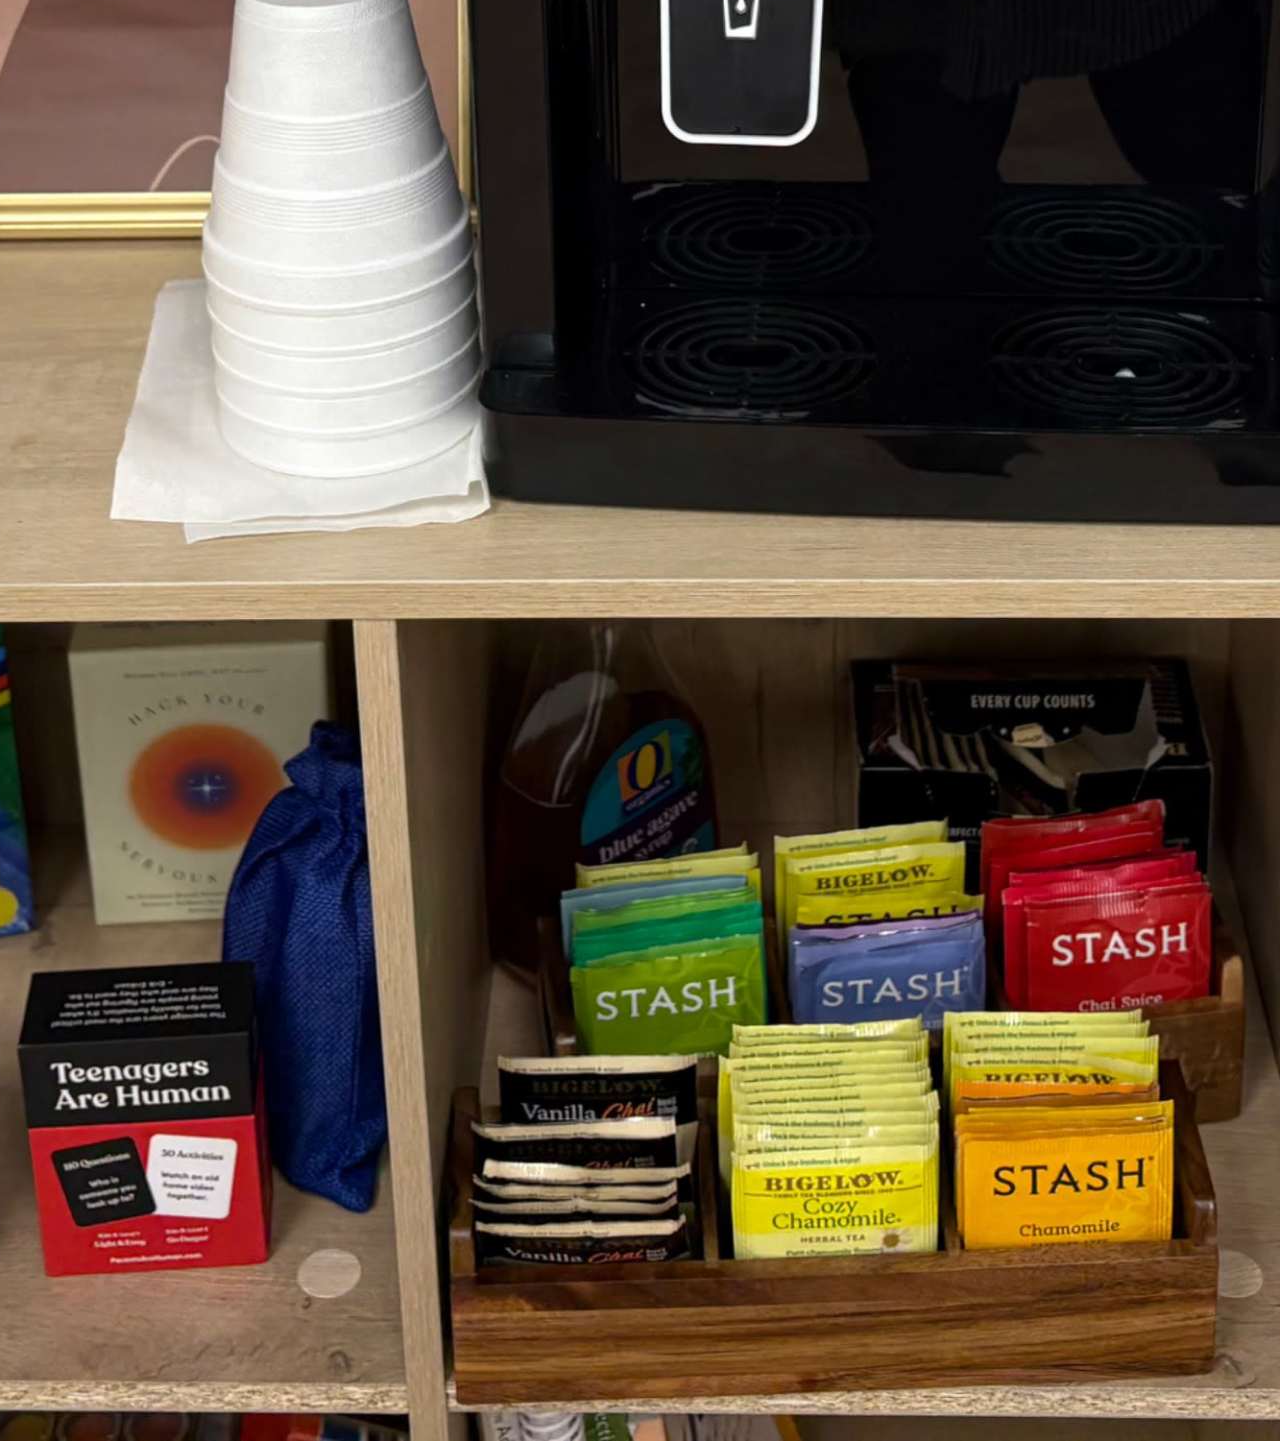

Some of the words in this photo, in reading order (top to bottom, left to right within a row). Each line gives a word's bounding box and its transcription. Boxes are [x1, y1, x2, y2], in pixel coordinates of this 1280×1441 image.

[128, 695, 188, 727] HACK
[203, 692, 266, 716] YOUR
[971, 694, 1011, 709] EVERY
[1014, 694, 1041, 709] CUP
[1043, 693, 1096, 709] COUNTS
[599, 829, 644, 864] blue
[646, 790, 699, 836] agave
[1052, 922, 1188, 967] STASH
[596, 976, 737, 1021] STASH
[822, 969, 961, 1008] STASH
[1078, 996, 1116, 1012] Chai
[49, 1059, 209, 1084] Teenagers
[54, 1089, 110, 1111] Are
[115, 1084, 231, 1107] Human
[521, 1102, 596, 1121] Vanilla
[602, 1096, 656, 1120] Chai
[80, 1152, 131, 1169] Questions
[177, 1150, 224, 1161] Activities
[88, 1178, 108, 1188] Who
[993, 1157, 1146, 1197] STASH
[803, 1199, 858, 1215] Cozy
[1019, 1219, 1120, 1237] Chamomile
